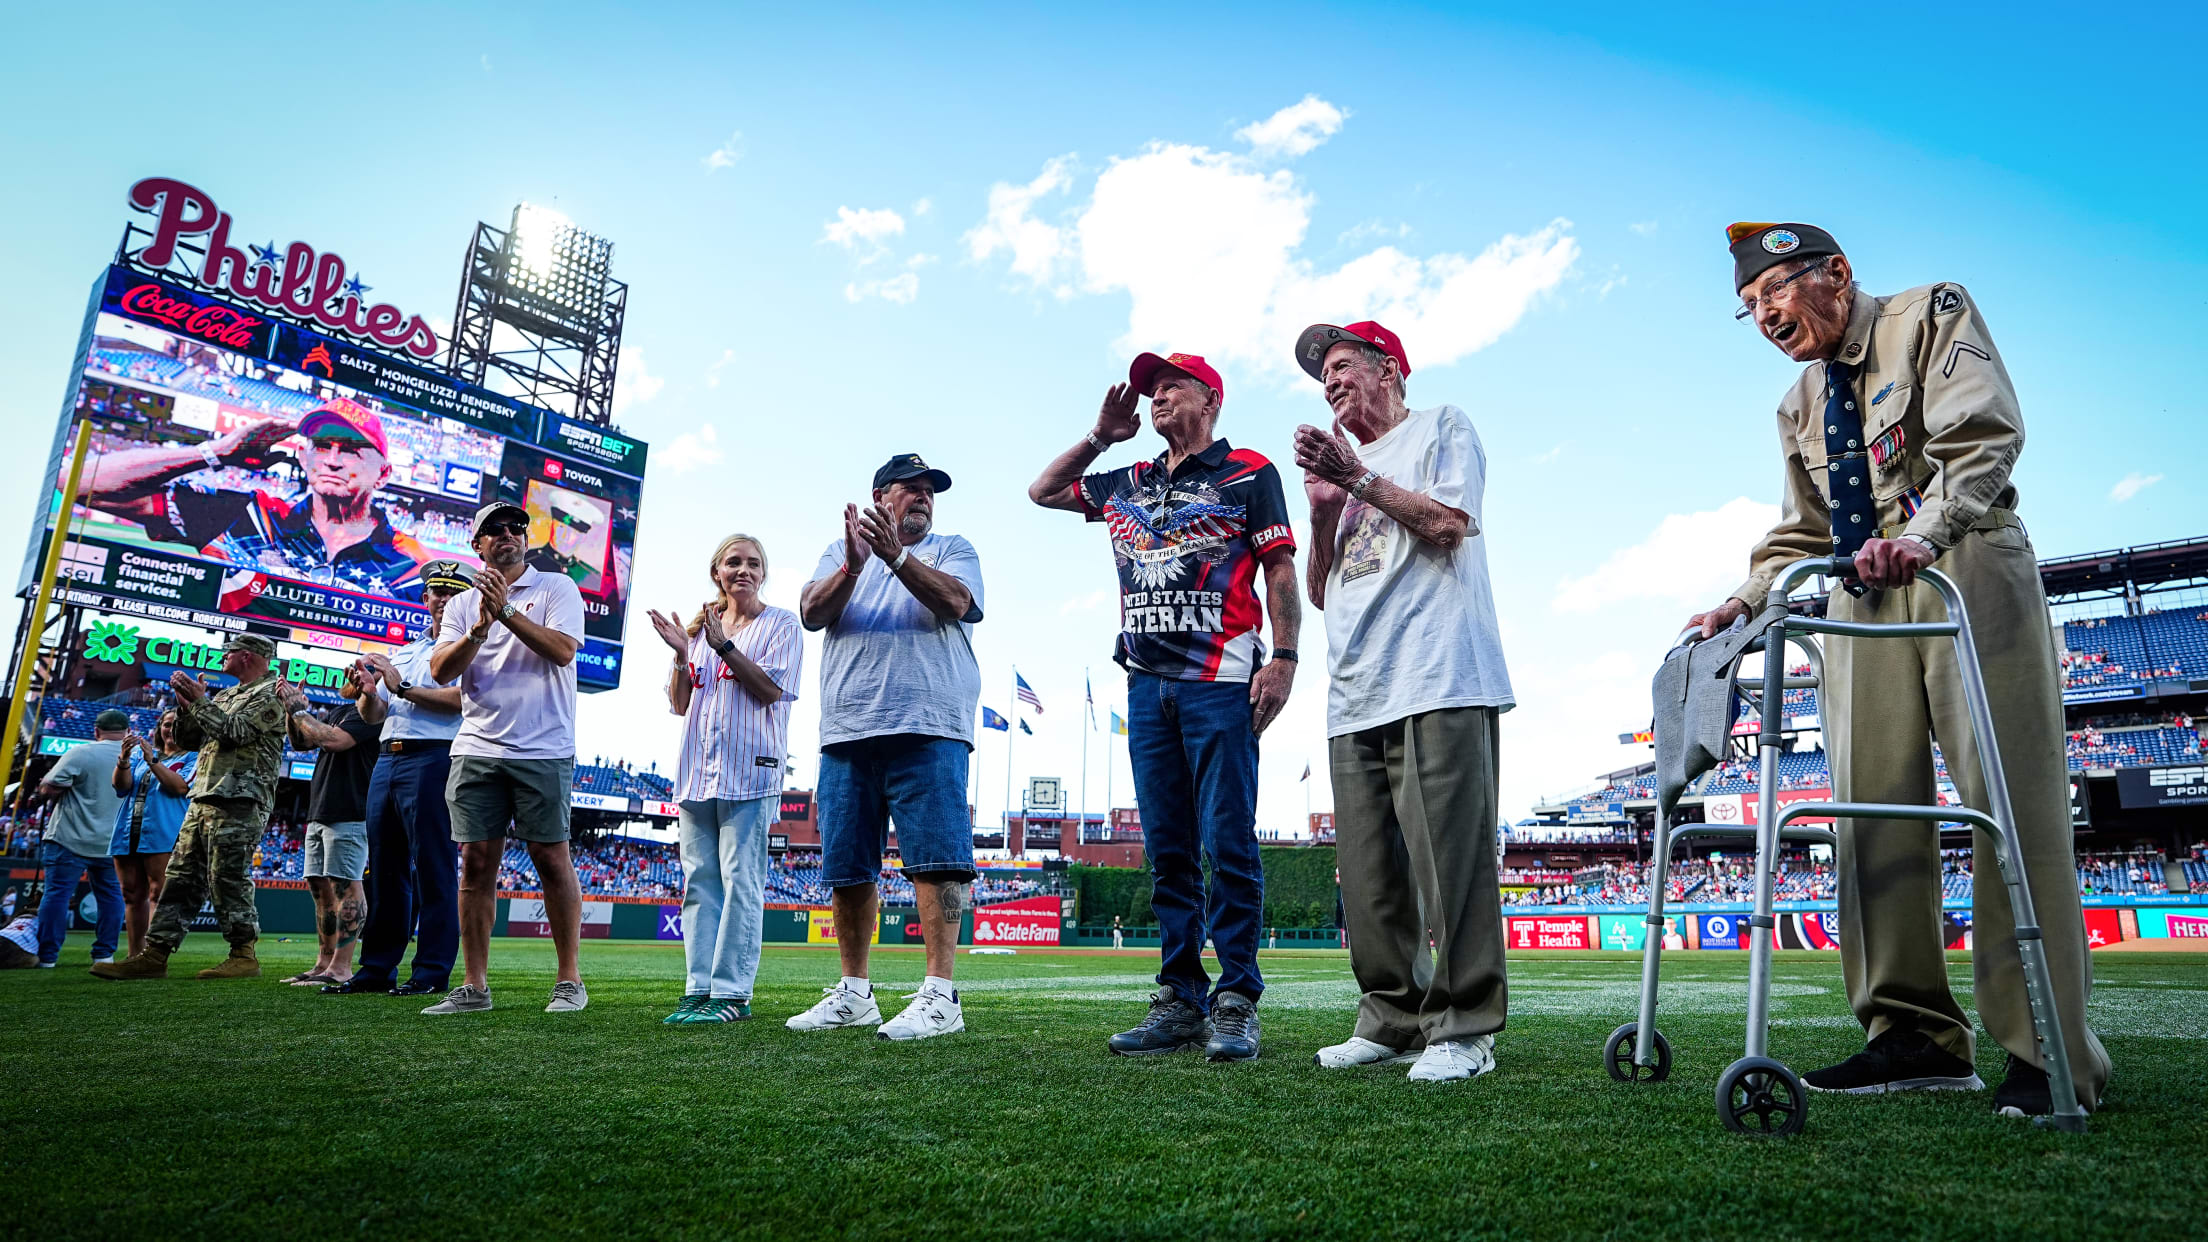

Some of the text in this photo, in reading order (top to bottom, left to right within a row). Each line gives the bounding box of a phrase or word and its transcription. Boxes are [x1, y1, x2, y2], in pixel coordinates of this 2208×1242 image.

[128, 177, 438, 358] Phillies
[339, 353, 518, 419] SALTZ MONGELUZZI BENDESKY
[374, 377, 484, 419] INJURY LAWYERS
[566, 437, 624, 462] SPORTSBOOK
[564, 468, 603, 488] TOYOTA
[1157, 548, 1176, 558] THE
[1179, 537, 1211, 554] BRAVE
[118, 564, 184, 587] financial
[121, 551, 206, 580] Connecting
[115, 578, 181, 599] services.
[1152, 590, 1223, 606] STATES
[57, 588, 106, 607] BRTHDAY.
[112, 598, 146, 613] PLEASE
[147, 605, 190, 621] WELCOME
[193, 612, 224, 627] ROBERT
[224, 617, 248, 631] DAUB
[249, 580, 432, 626] SALUTE TO SERVICE
[289, 607, 364, 629] PRESENTED
[368, 622, 385, 633] BY
[145, 637, 348, 689] Citizs Ban
[793, 911, 807, 923] 374
[884, 914, 900, 925] 387
[1537, 920, 1584, 934] Temple
[1538, 934, 1582, 947] Health
